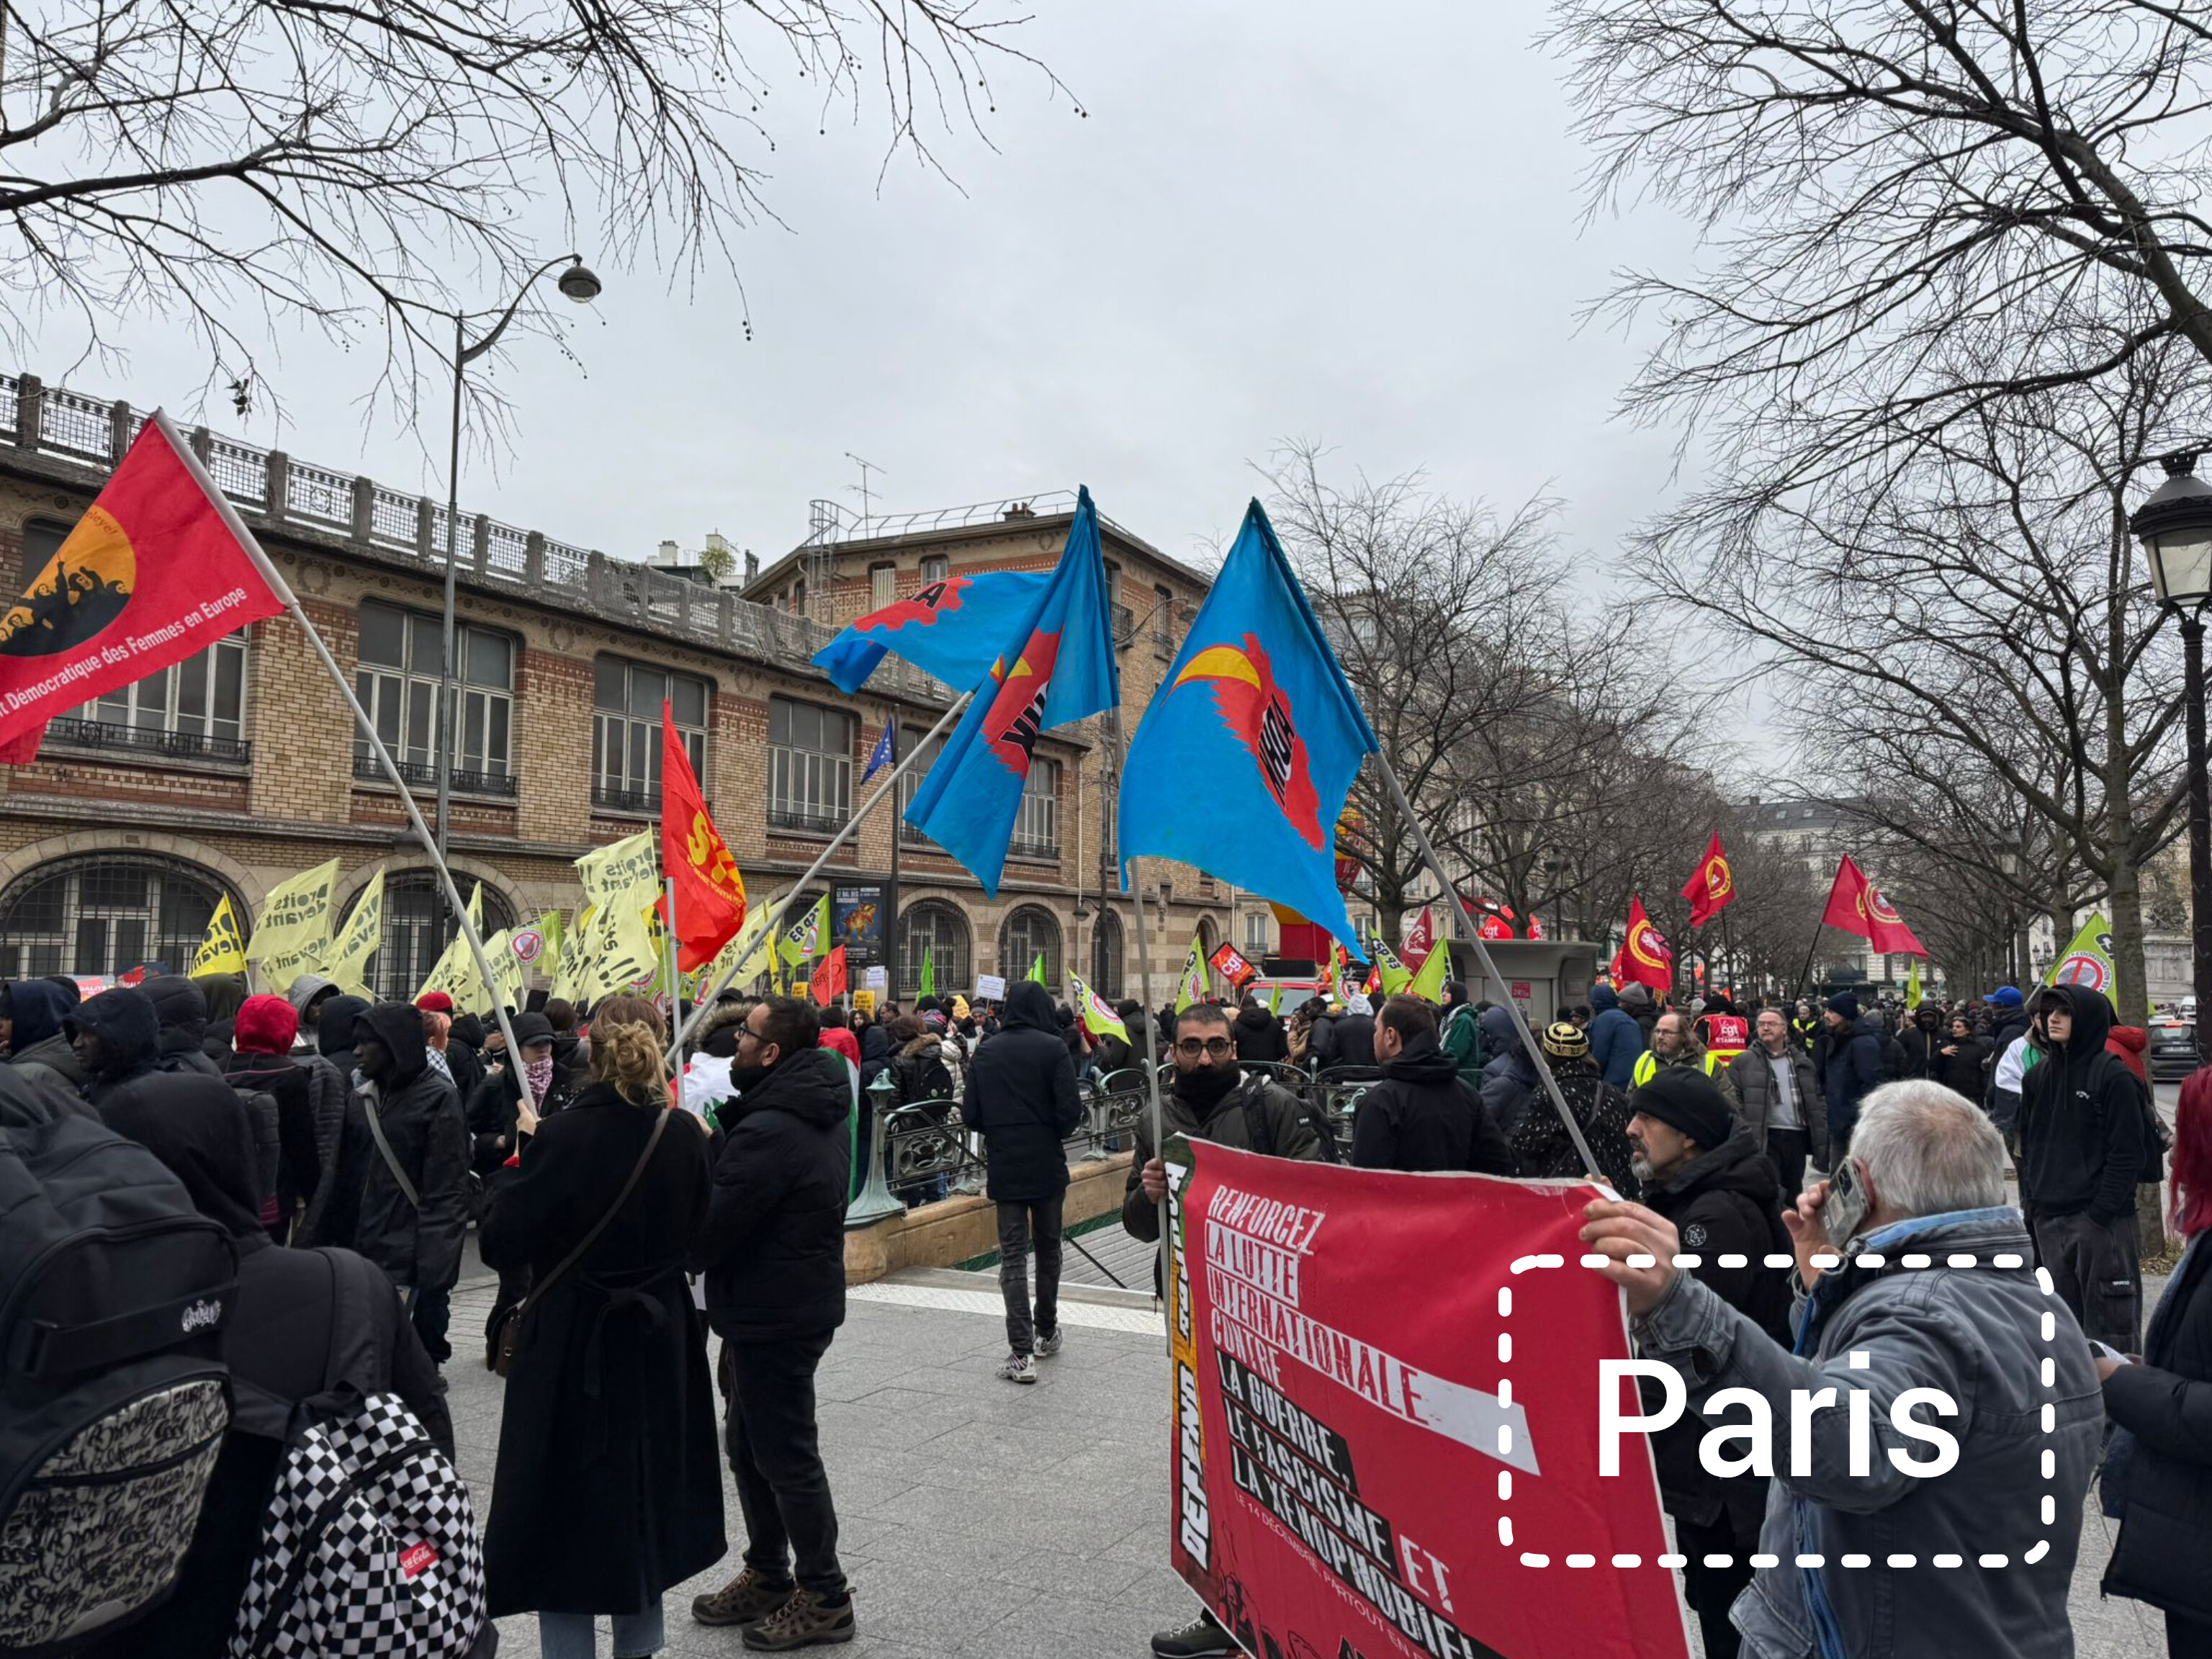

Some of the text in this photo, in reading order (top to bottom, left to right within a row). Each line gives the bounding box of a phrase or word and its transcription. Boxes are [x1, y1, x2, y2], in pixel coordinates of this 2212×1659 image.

[4, 655, 102, 710] Démocratique
[101, 646, 130, 664] des
[125, 621, 185, 655] Femmes
[184, 611, 204, 628] en
[199, 587, 248, 619] Europe
[1221, 953, 1243, 976] cgt
[1484, 926, 1499, 938] cgt
[1207, 1184, 1326, 1256] RENFORCEZ
[1206, 1224, 1299, 1305] LA LUTTE
[1208, 1265, 1431, 1426] INTERNATIONALE
[1210, 1307, 1285, 1393] CONTRE
[1217, 1351, 1244, 1400] LA
[1178, 1362, 1210, 1570] DEFEND
[1226, 1399, 1249, 1448] LE
[1249, 1418, 1391, 1568] FASCISME
[1231, 1443, 1264, 1501] LA
[1235, 1491, 1246, 1509] LE
[1248, 1503, 1260, 1519] 14
[1323, 1570, 1385, 1632] PARTOUT
[1387, 1628, 1411, 1658] EN
